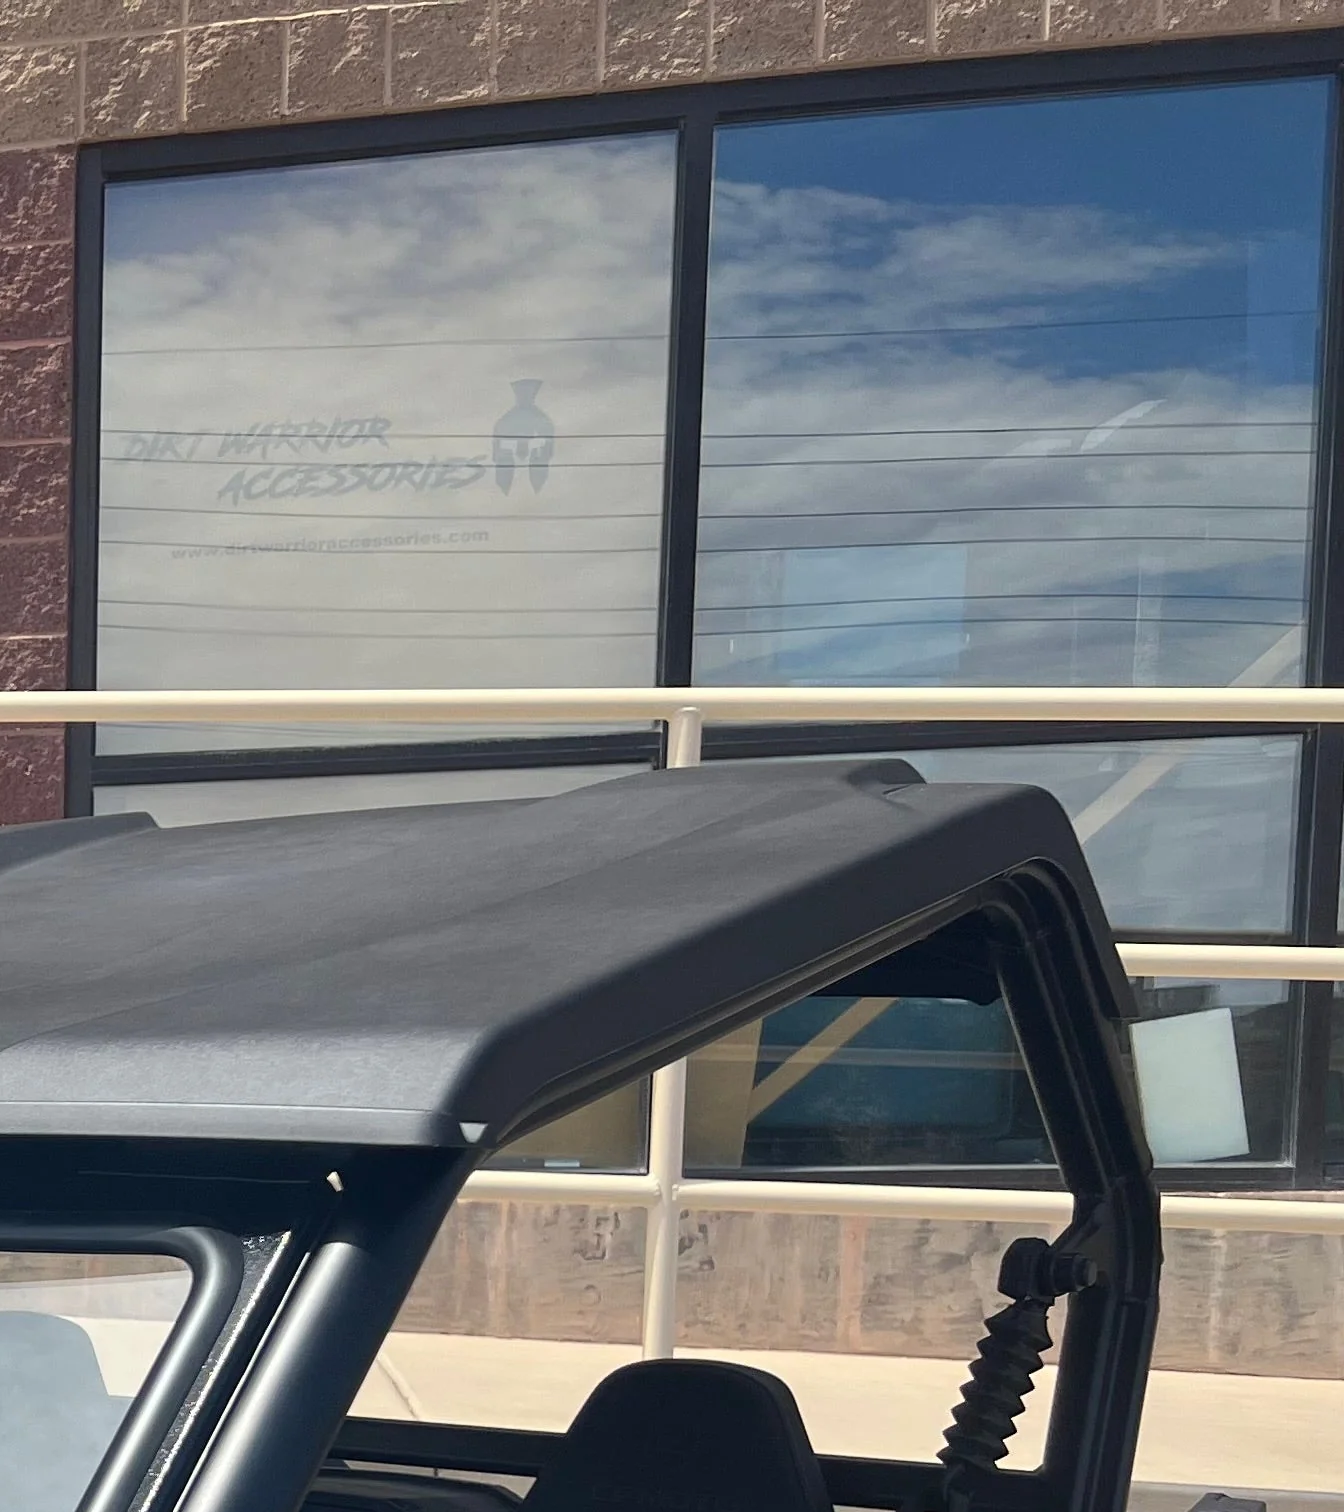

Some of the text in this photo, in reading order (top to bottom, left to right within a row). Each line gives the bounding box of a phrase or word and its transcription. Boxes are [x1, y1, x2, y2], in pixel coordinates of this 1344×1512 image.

[120, 415, 392, 463] DIRT WARRIOR
[217, 454, 487, 506] ACCESSORIES
